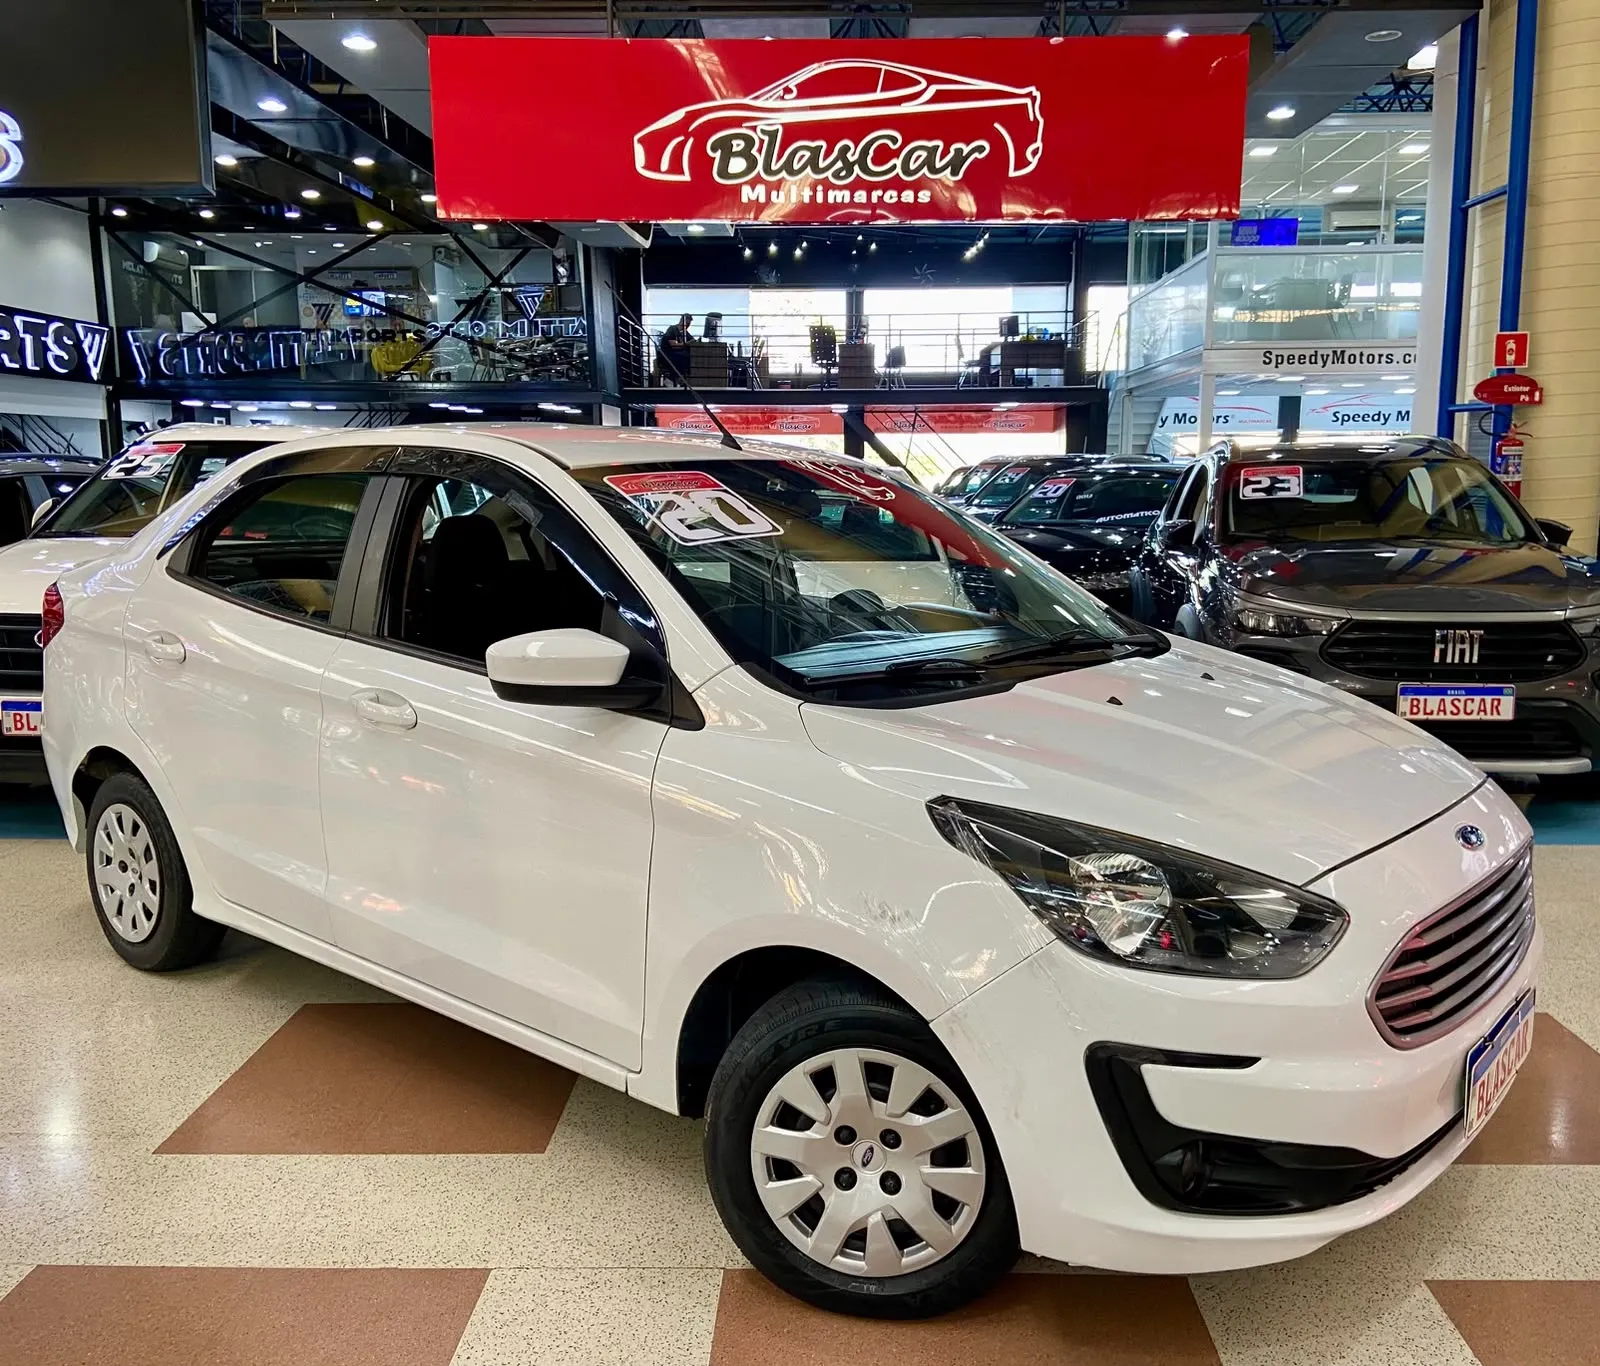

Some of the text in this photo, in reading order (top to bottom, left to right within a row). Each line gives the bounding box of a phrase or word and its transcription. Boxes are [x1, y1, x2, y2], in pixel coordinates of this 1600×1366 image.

[707, 124, 989, 184] BlasCar
[741, 183, 931, 204] Multimarcas
[1263, 350, 1416, 368] SpeedyMotors.c
[1332, 410, 1391, 426] Speedy
[1034, 484, 1066, 498] 20
[1243, 476, 1300, 497] 23
[645, 490, 773, 540] 20
[1434, 629, 1484, 663] FIAT
[1409, 697, 1502, 716] BLASCAR
[1477, 1019, 1529, 1121] BLASCAR
